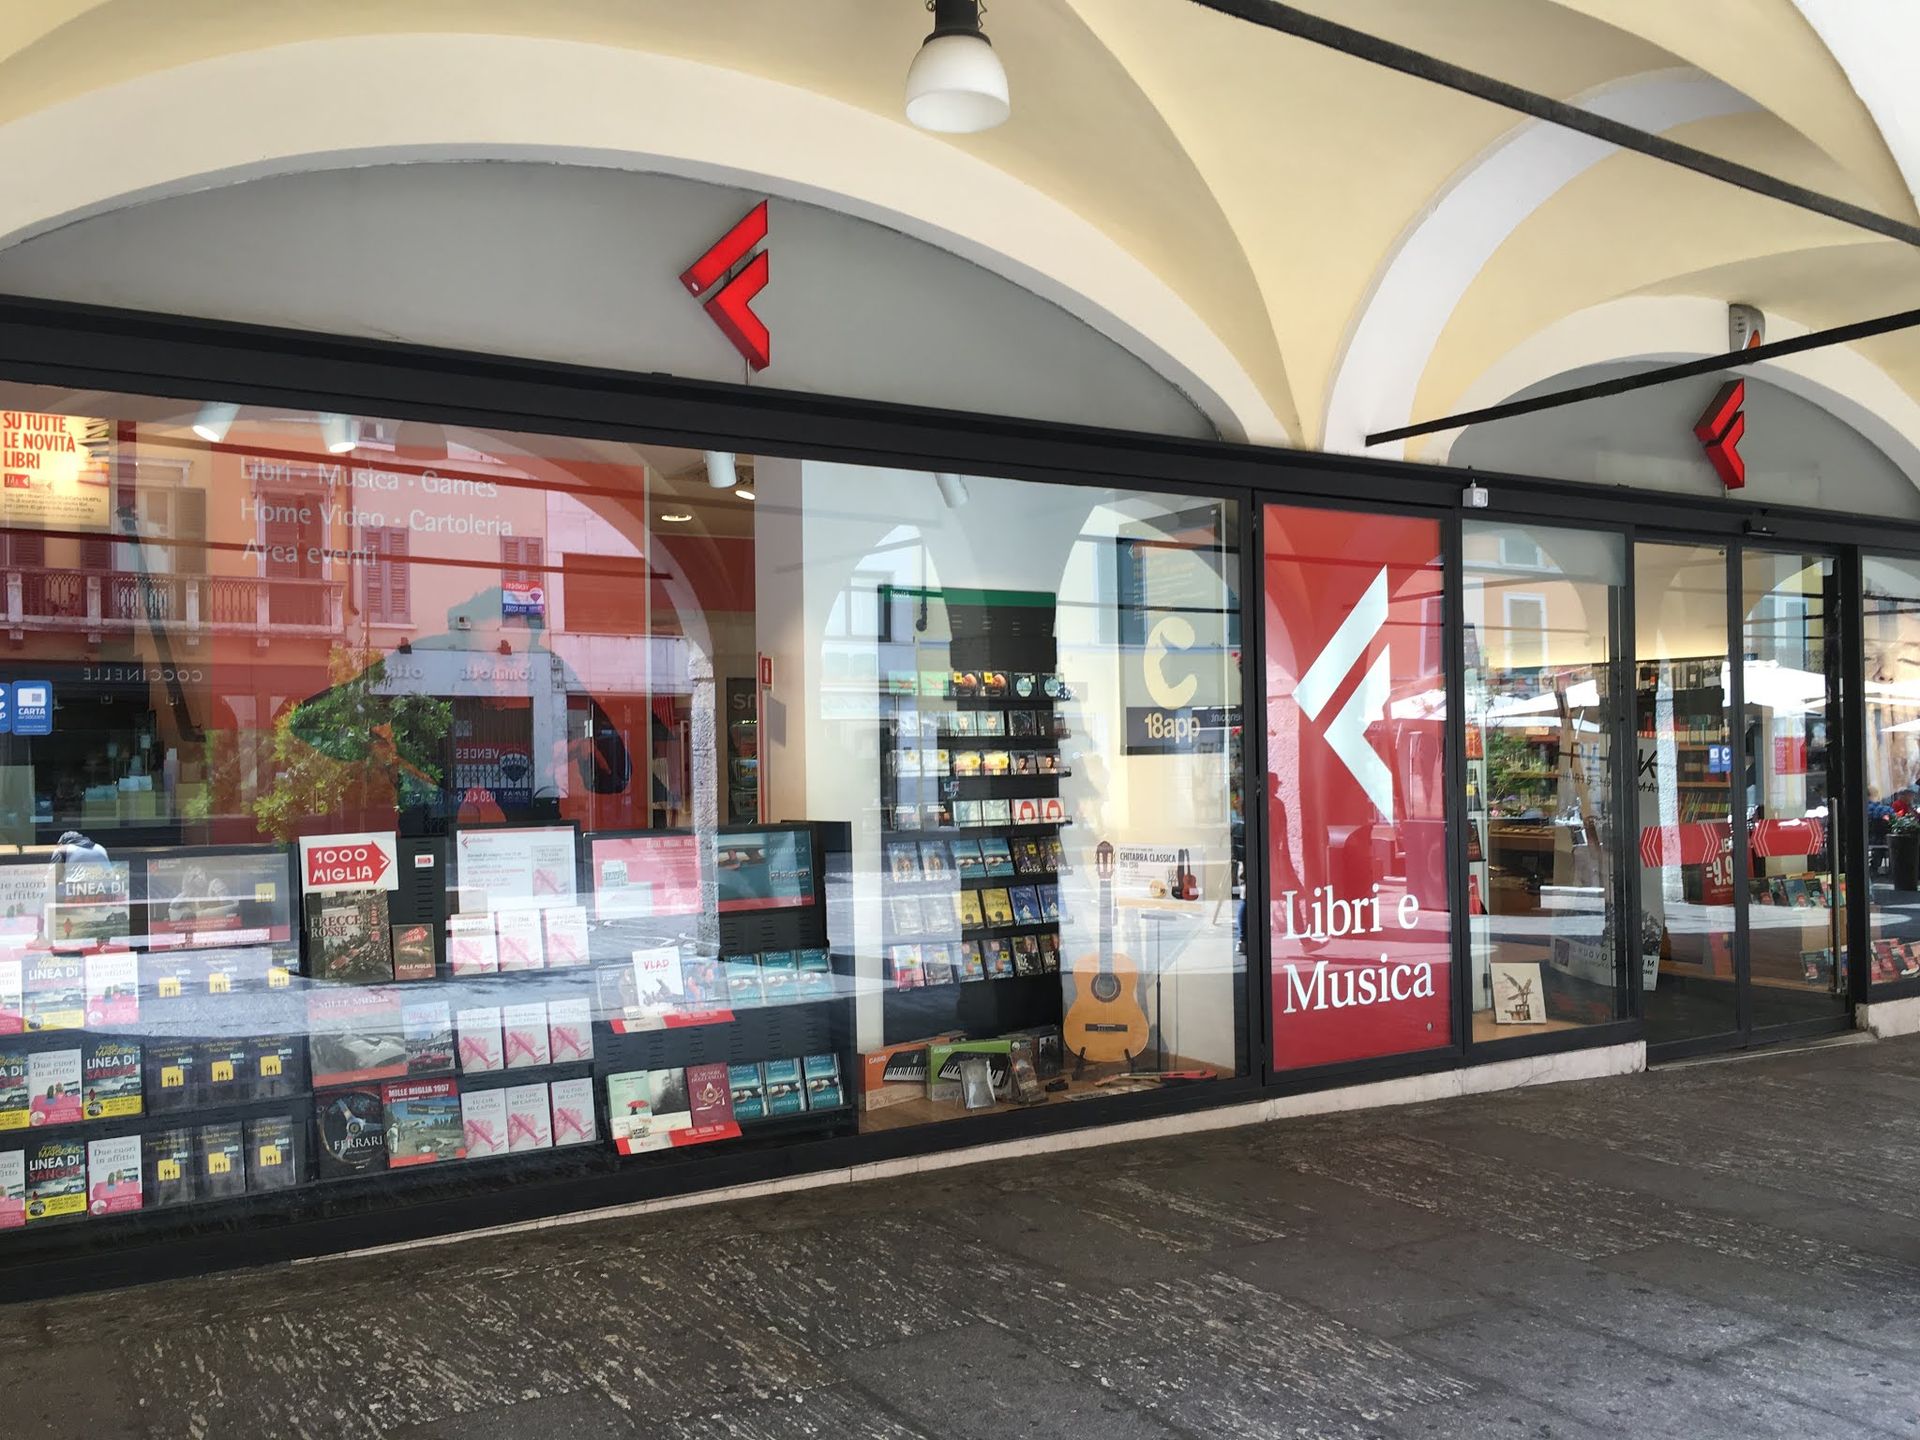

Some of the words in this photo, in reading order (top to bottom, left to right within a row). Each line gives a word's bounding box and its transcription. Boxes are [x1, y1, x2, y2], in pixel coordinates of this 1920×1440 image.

[3, 412, 22, 430] SU
[25, 415, 67, 434] TUTTE
[3, 432, 20, 450] LE
[23, 431, 76, 454] NOVITÀ
[3, 451, 41, 470] LIBRI
[241, 457, 292, 484] Libri
[318, 463, 400, 491] Musica
[421, 470, 499, 499] Games
[240, 501, 313, 526] Home
[321, 502, 386, 529] Video
[409, 508, 514, 539] Cartoleria
[241, 541, 298, 564] Area
[306, 546, 378, 570] eventi
[18, 706, 47, 716] CARTA
[1144, 711, 1201, 744] 18app
[315, 848, 368, 865] 1000
[1119, 852, 1149, 863] CHITARRA
[1149, 853, 1177, 864] CLASSICA
[312, 865, 373, 883] MIGLIA
[65, 882, 108, 897] LINEA
[110, 882, 126, 894] DI
[310, 913, 363, 929] FRECCE
[1281, 882, 1384, 943] Libri
[1397, 892, 1420, 930] e
[311, 926, 348, 940] ROSSE
[643, 958, 670, 971] VLAD
[28, 968, 63, 982] LINEA
[65, 966, 80, 977] DI
[1282, 954, 1436, 1014] Musica
[86, 1056, 118, 1070] LINEA
[123, 1053, 136, 1065] DI
[868, 1055, 887, 1065] CASIO
[388, 1088, 408, 1099] MILLE
[408, 1087, 433, 1097] MIGLIA
[333, 1134, 384, 1151] FERRARI
[93, 1148, 112, 1157] Due
[113, 1146, 137, 1155] cuori
[29, 1159, 60, 1172] LINEA
[66, 1154, 80, 1167] DI
[29, 1166, 81, 1182] SANGUE
